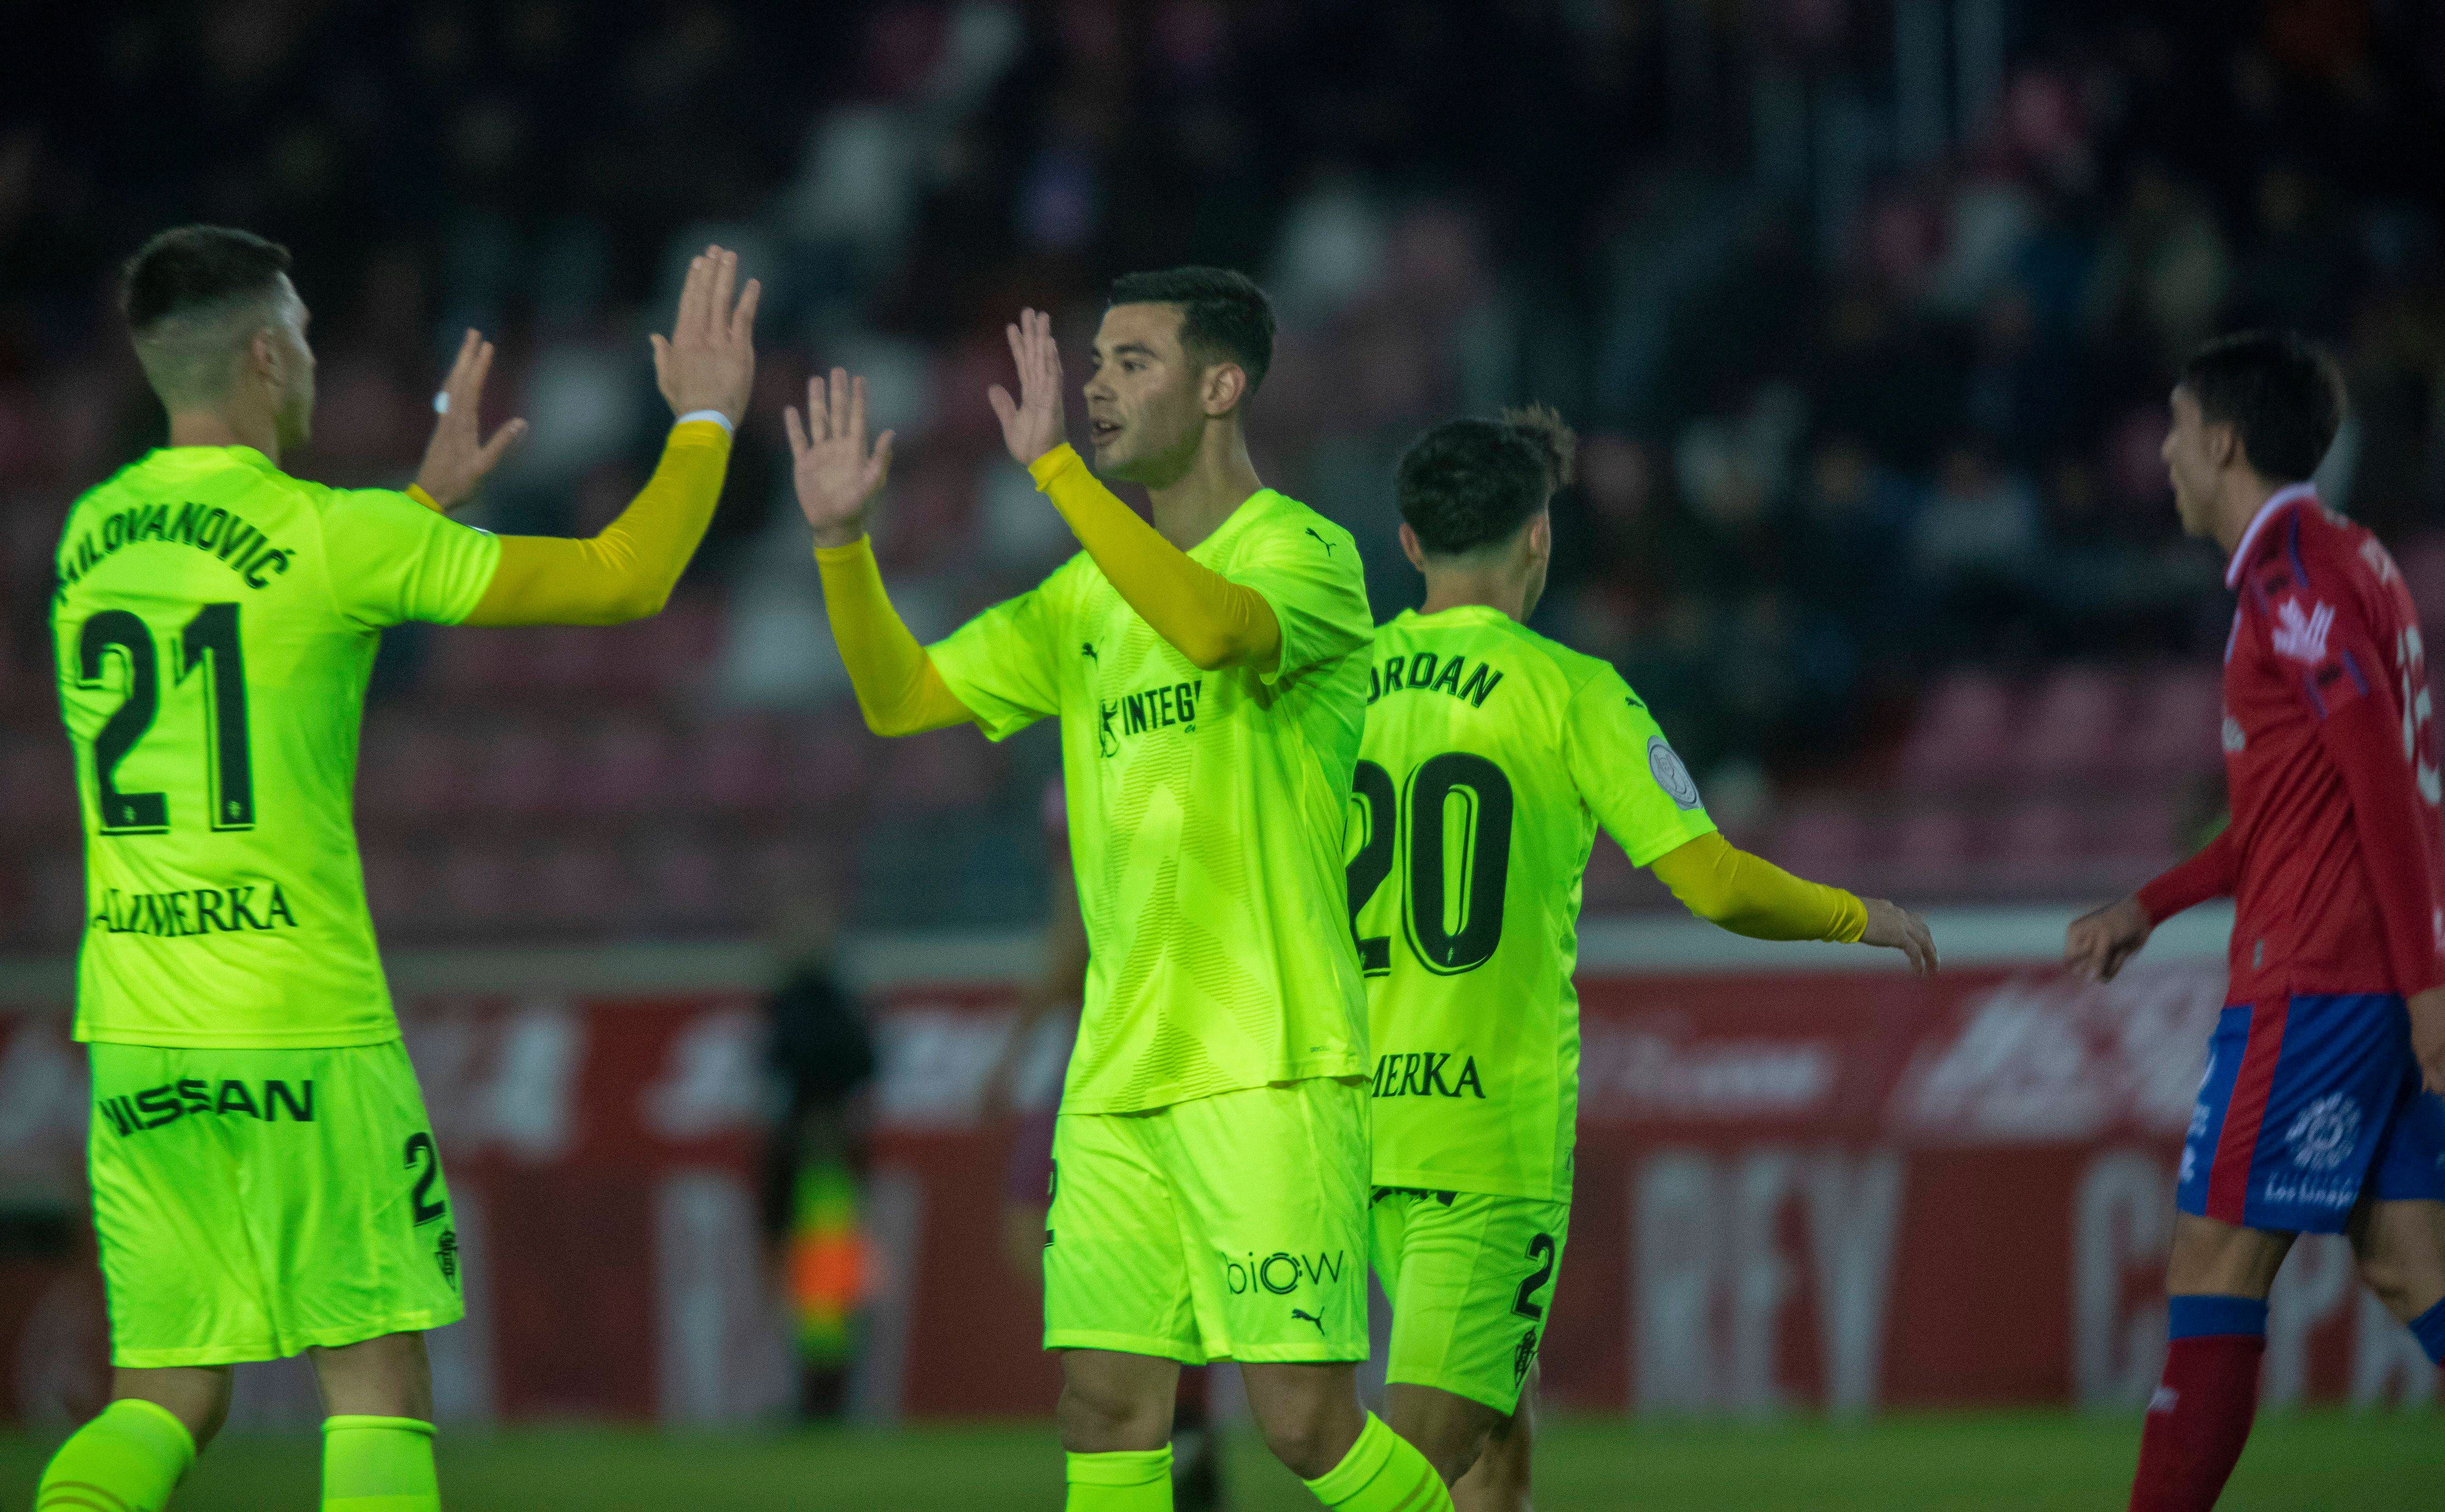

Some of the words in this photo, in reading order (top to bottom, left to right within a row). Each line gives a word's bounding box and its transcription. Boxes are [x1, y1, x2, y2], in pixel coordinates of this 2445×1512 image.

[76, 602, 255, 836] 21
[1343, 751, 1513, 977] 20
[98, 1079, 315, 1137] NISSAN
